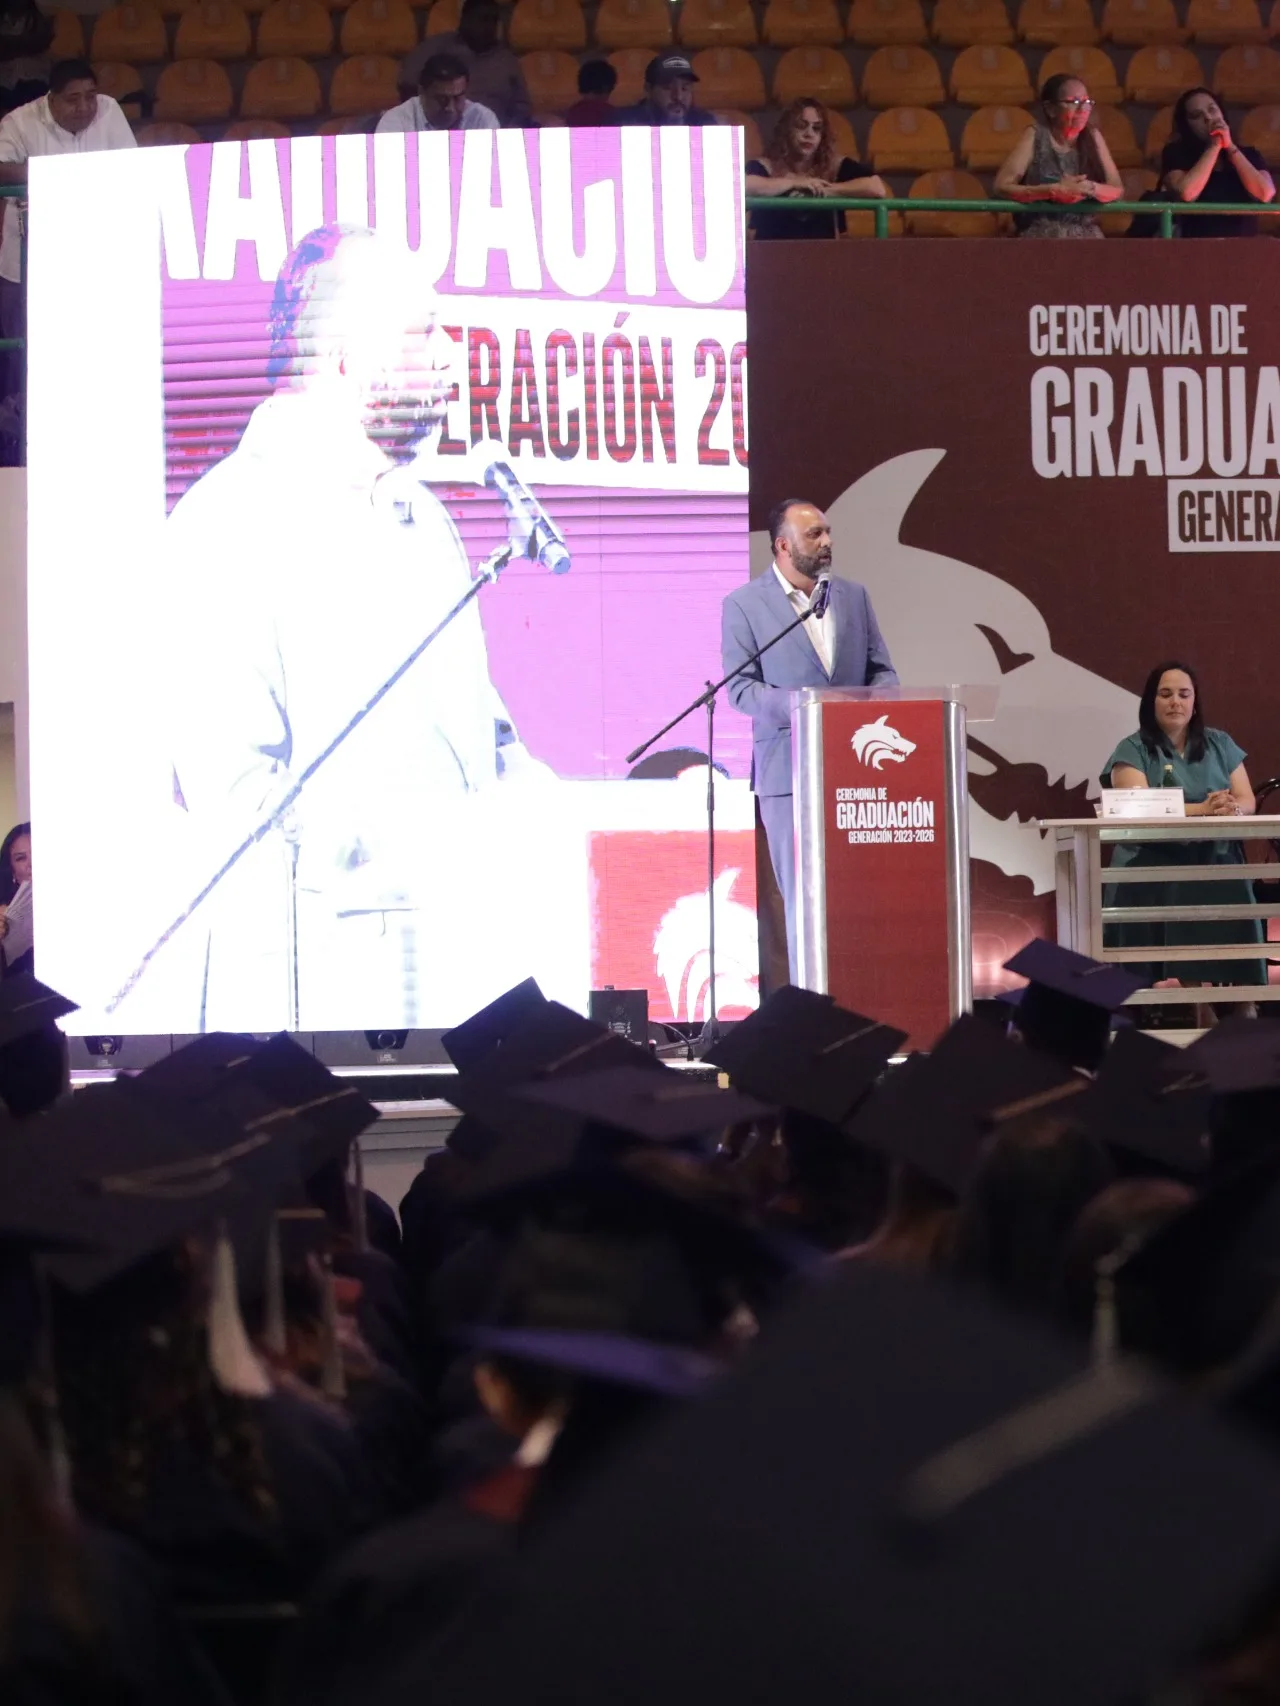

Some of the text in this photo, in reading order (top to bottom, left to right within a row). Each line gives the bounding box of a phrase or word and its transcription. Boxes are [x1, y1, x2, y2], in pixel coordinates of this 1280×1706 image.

[1028, 304, 1248, 357] CEREMONIA DE
[836, 787, 888, 801] CEREMONIA DE
[836, 796, 934, 829] GRADUACIÓN
[848, 829, 892, 844] GENERACIÓN
